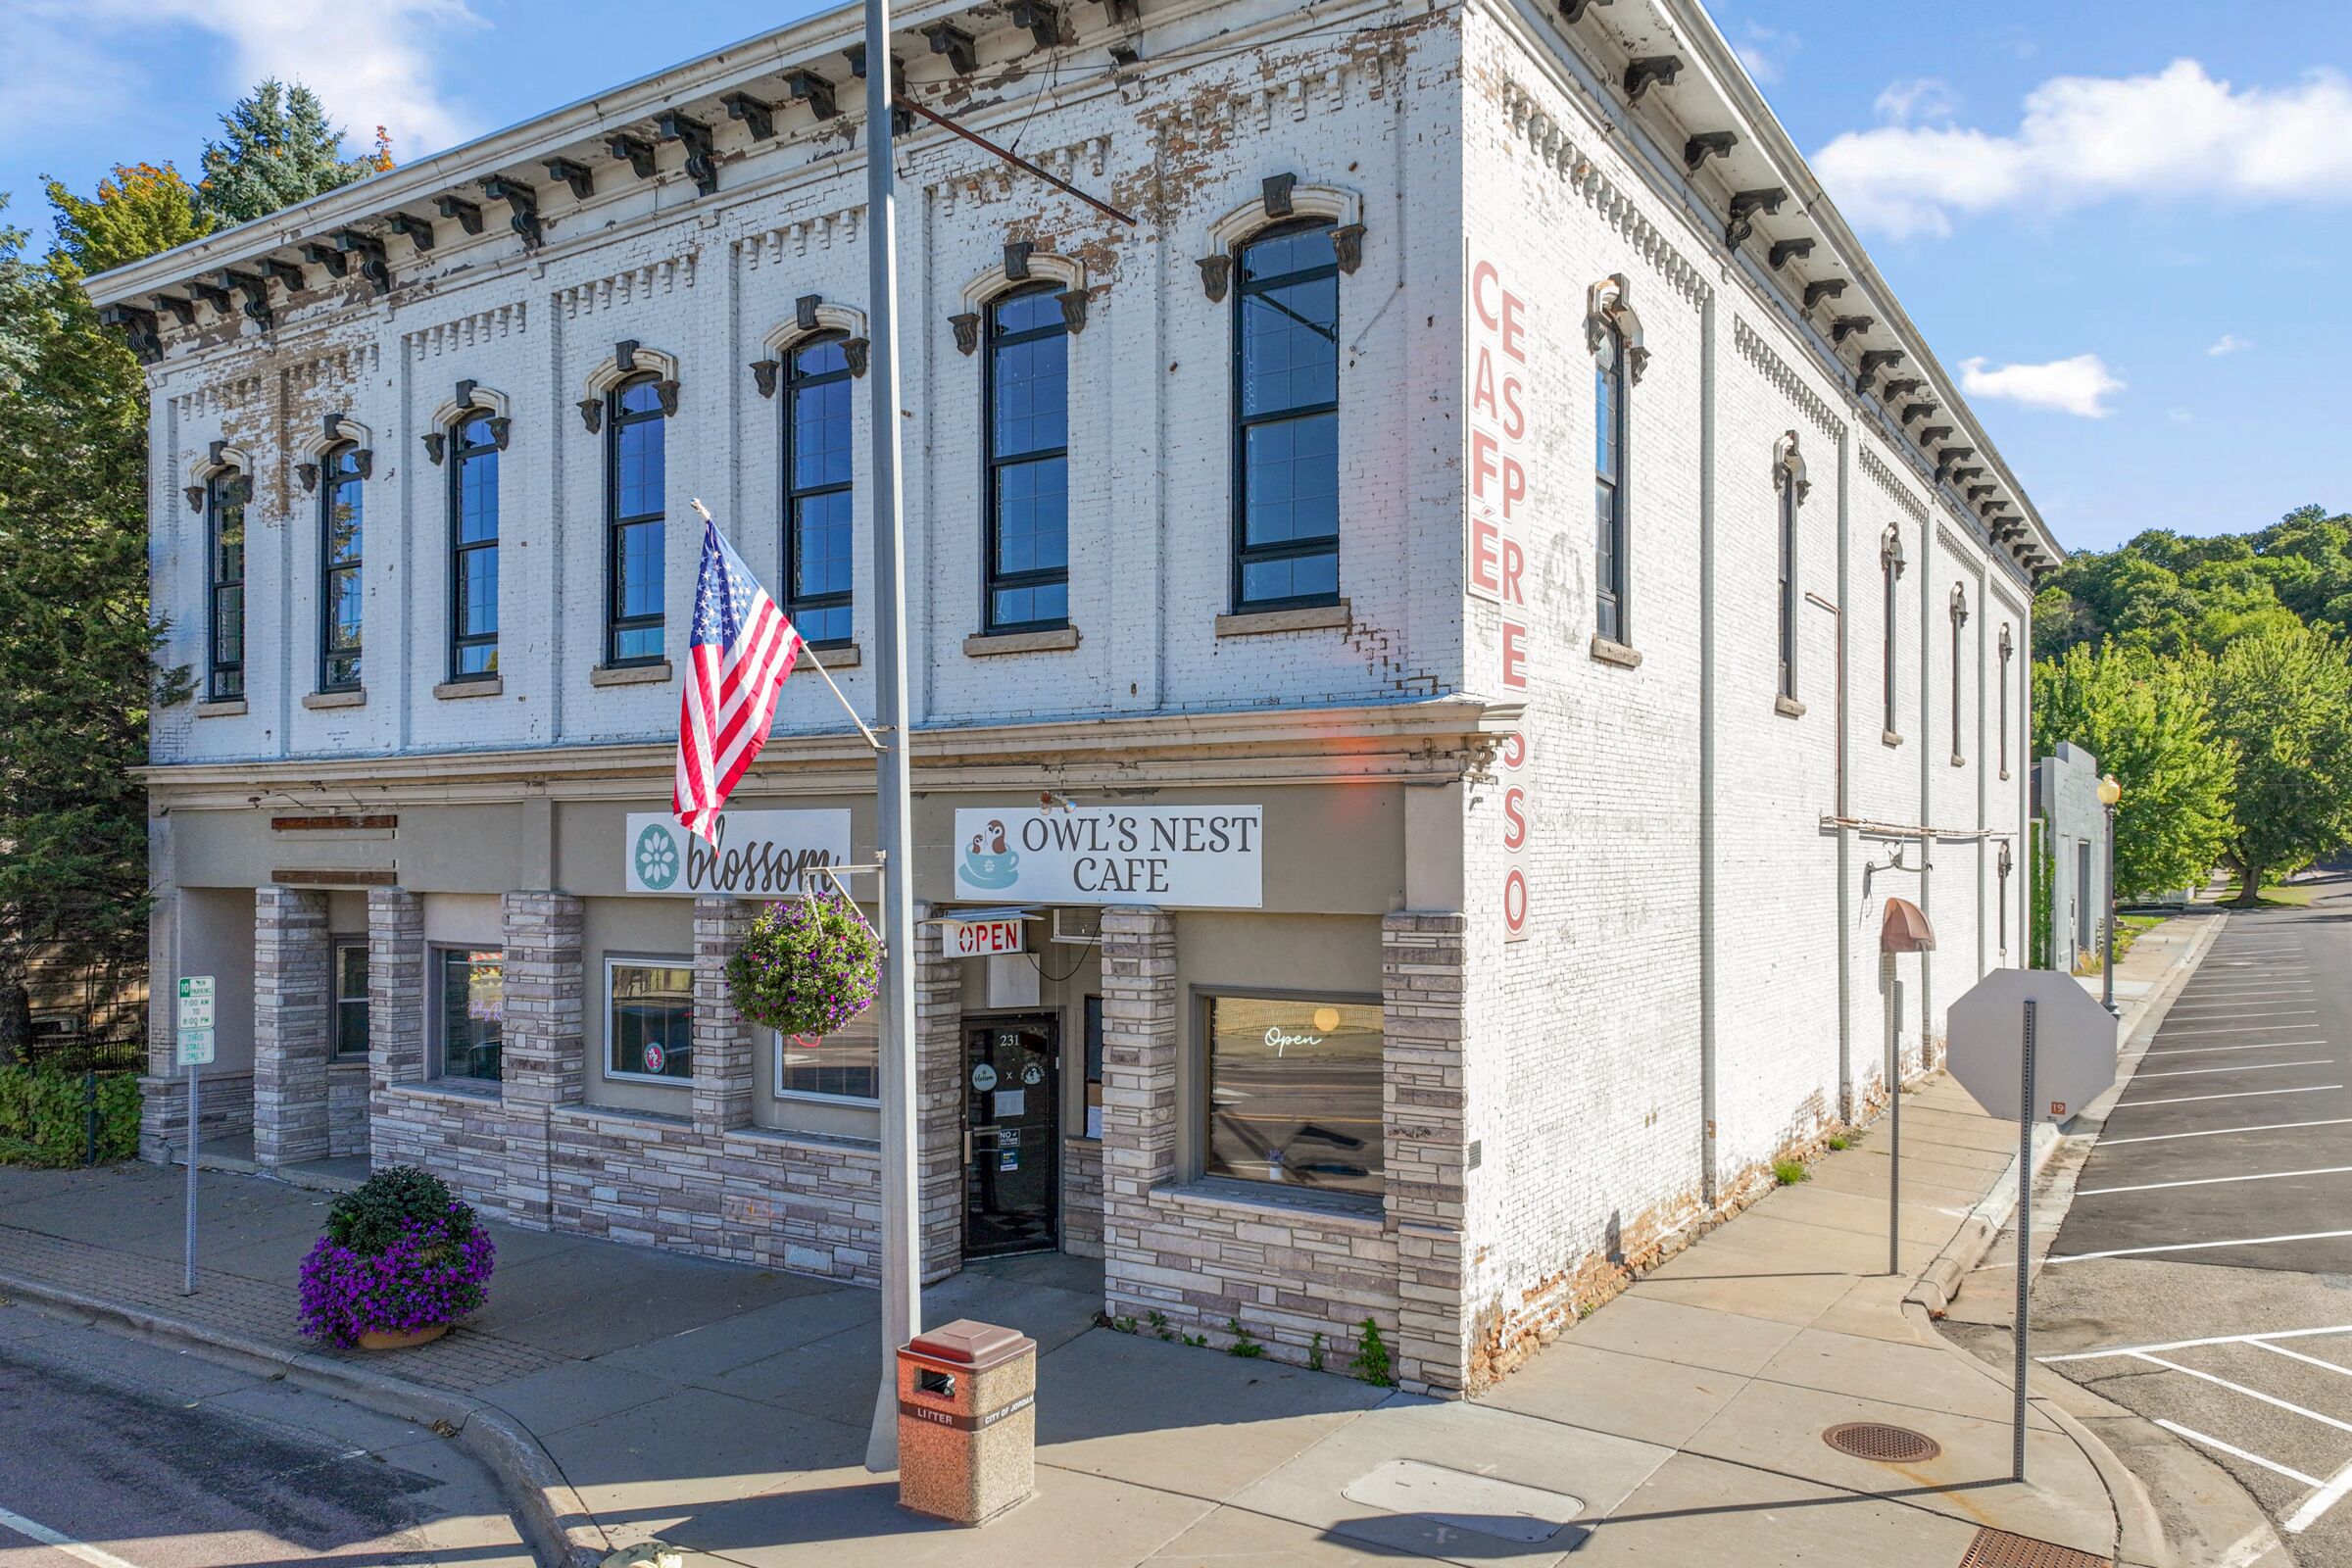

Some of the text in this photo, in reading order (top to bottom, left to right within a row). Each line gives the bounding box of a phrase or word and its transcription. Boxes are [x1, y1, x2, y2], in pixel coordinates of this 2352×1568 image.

[1472, 260, 1498, 592] CAFÉ
[1501, 288, 1527, 931] ESPRESSO
[1150, 816, 1258, 853] NEST
[687, 813, 841, 893] blossom
[1073, 857, 1169, 893] CAFE
[958, 922, 1018, 954] OPEN
[181, 983, 189, 994] 10
[190, 987, 213, 996] PARKING
[1000, 1034, 1020, 1047] 231
[1264, 1026, 1323, 1057] Open
[2053, 1103, 2064, 1113] 19
[917, 1408, 953, 1426] LITTER
[985, 1395, 1034, 1425] CITY OF JORDAN
